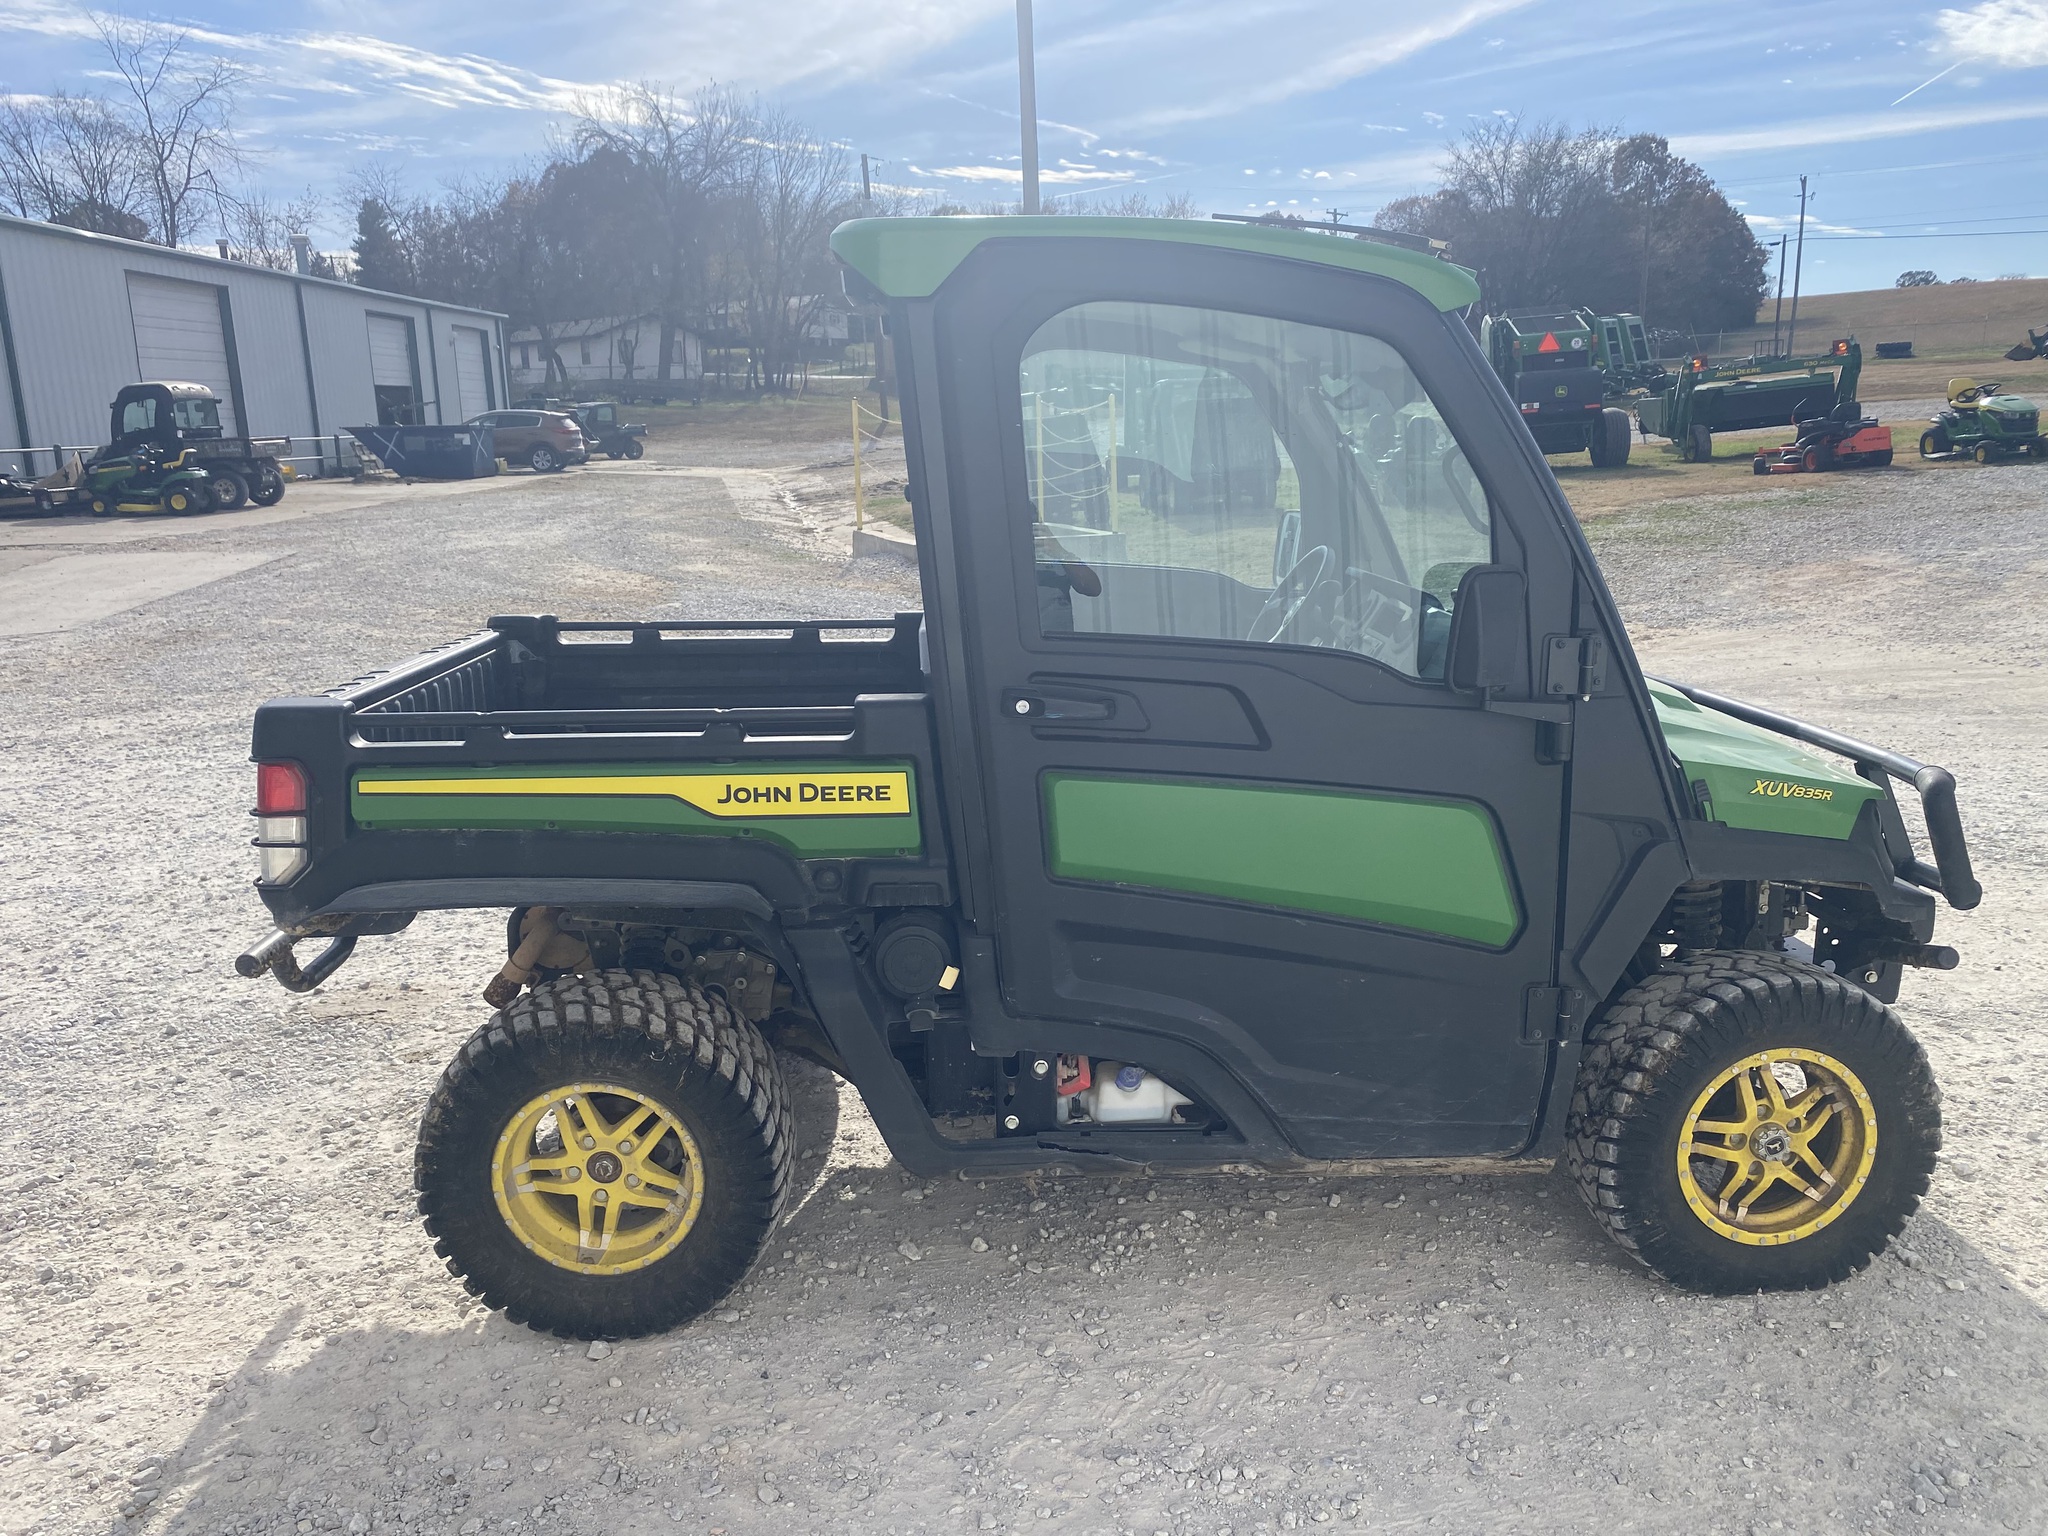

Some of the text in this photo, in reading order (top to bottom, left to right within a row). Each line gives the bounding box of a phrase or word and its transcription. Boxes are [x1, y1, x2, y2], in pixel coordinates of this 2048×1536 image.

[717, 783, 891, 804] JOHN DEERE
[1749, 779, 1833, 801] XUV835R
